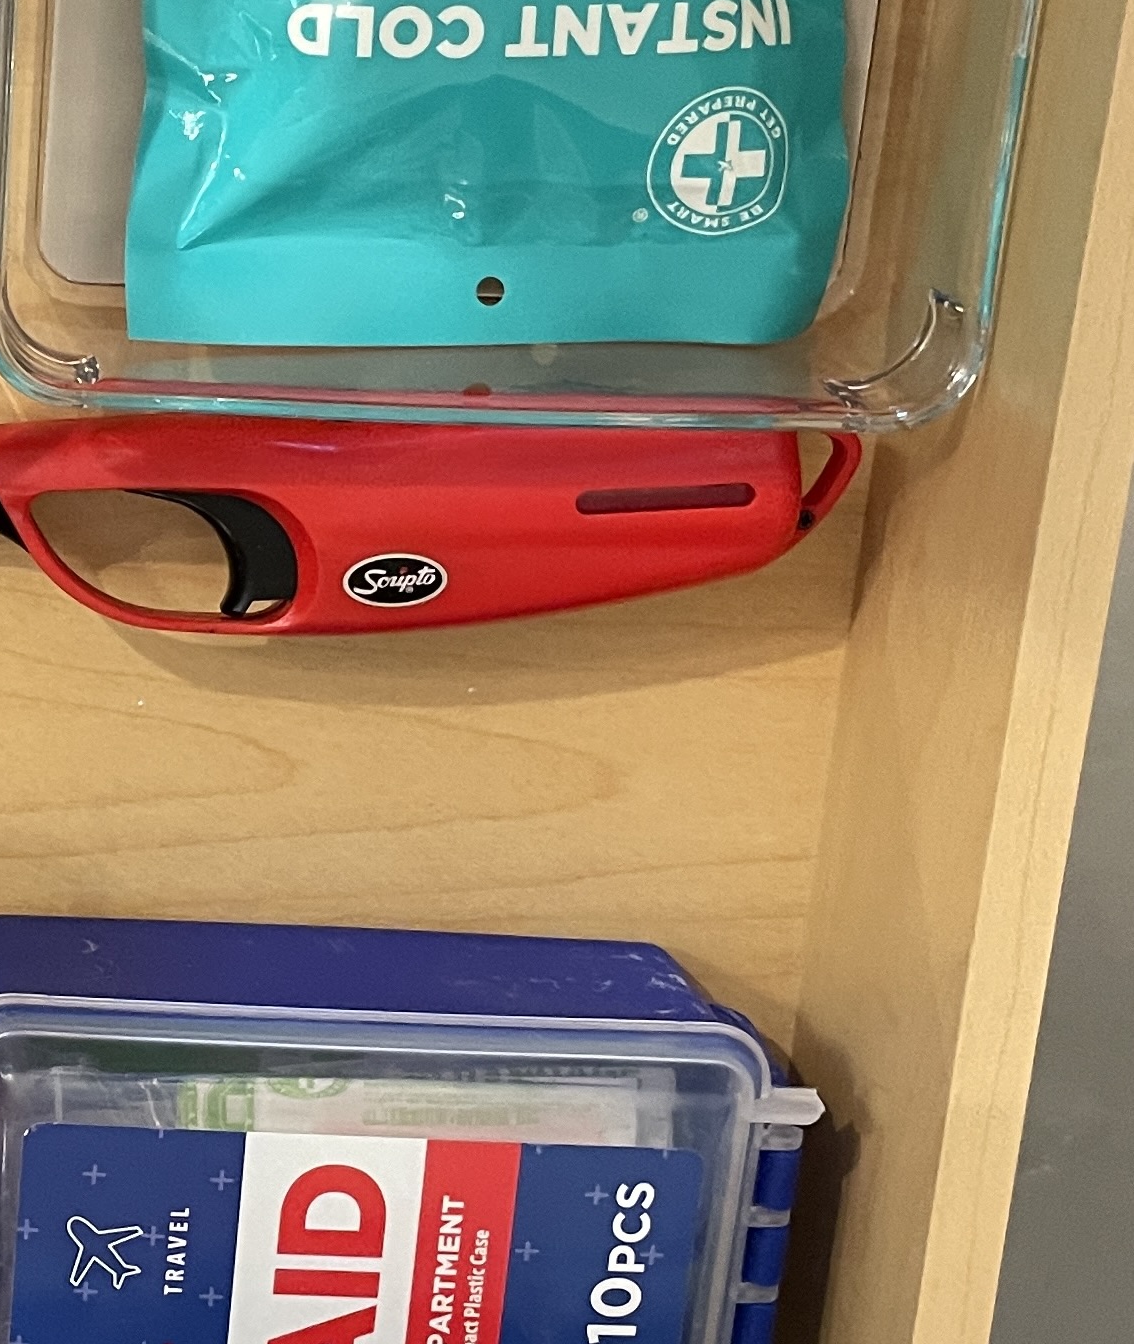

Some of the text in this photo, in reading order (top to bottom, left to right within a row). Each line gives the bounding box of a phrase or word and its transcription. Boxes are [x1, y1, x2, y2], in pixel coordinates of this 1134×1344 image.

[286, 2, 484, 59] COLD
[666, 95, 782, 147] GET PREPARED
[665, 200, 764, 229] BE SMART
[353, 565, 436, 596] Scripto
[162, 1207, 190, 1295] TRAVEL
[469, 1229, 490, 1265] Case
[463, 1268, 486, 1318] Plastic
